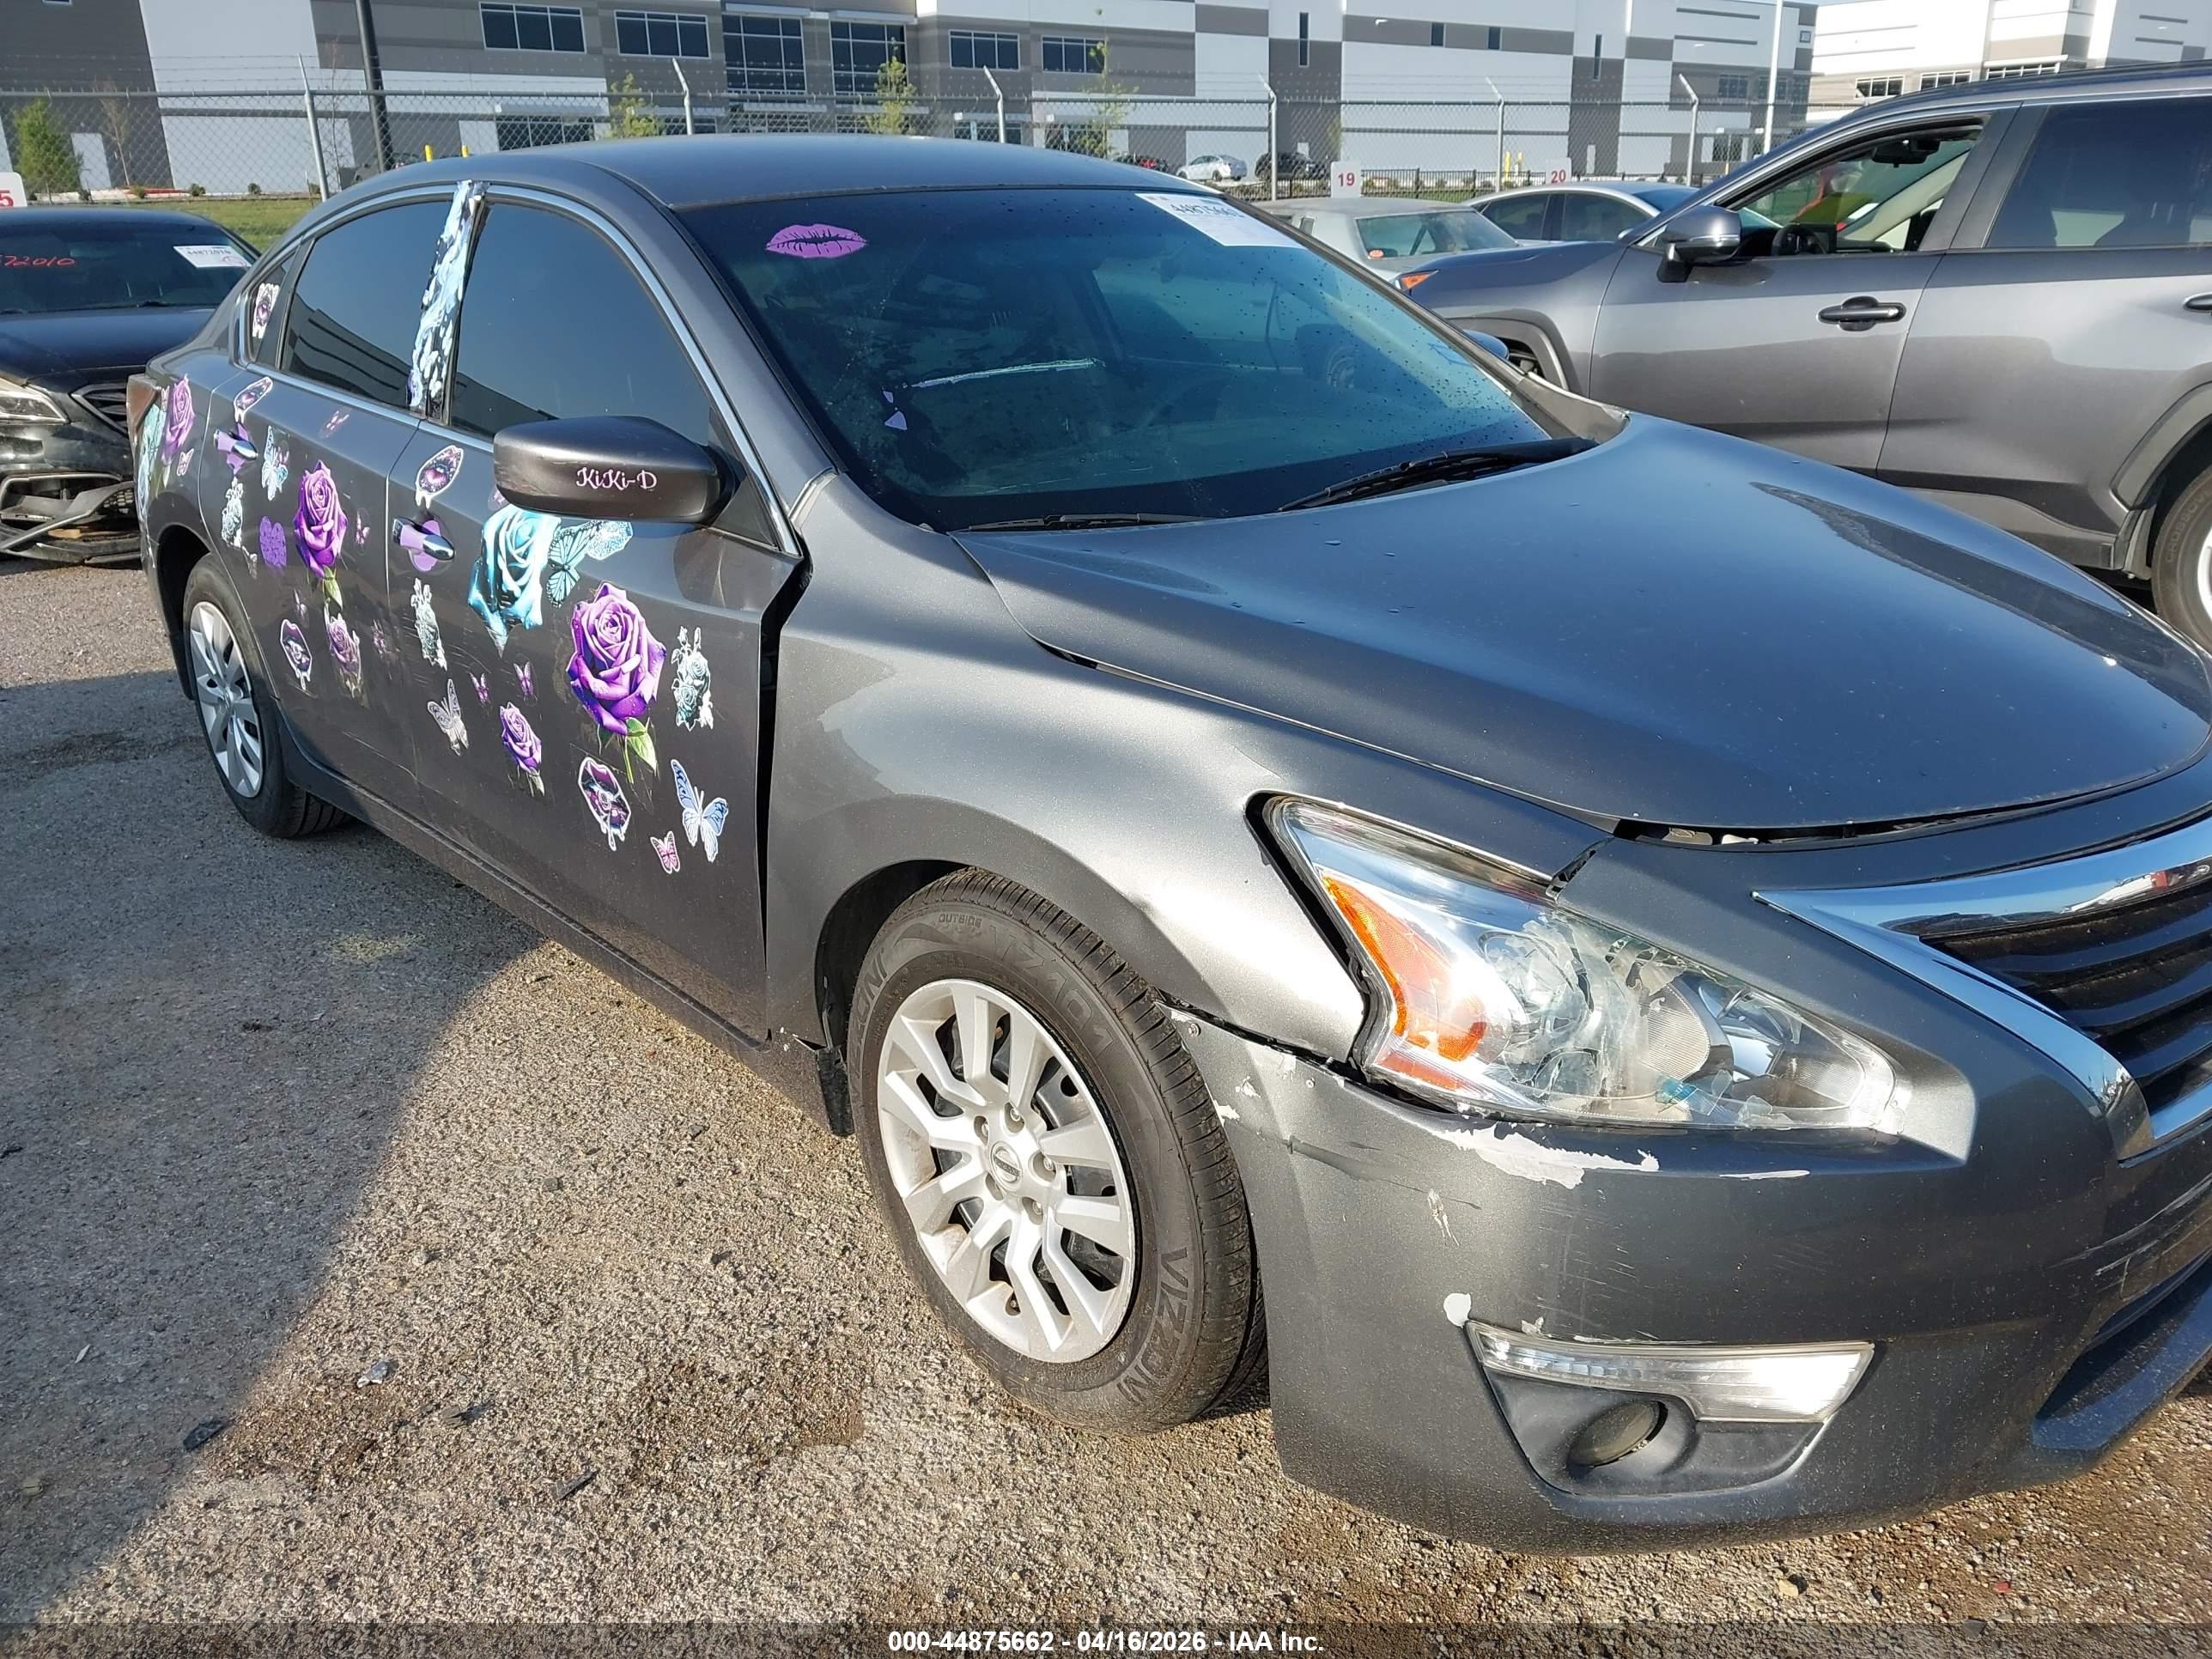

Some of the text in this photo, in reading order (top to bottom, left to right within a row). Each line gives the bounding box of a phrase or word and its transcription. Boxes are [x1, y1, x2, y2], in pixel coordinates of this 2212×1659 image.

[1338, 172, 1355, 186] 19
[1551, 169, 1566, 184] 20
[576, 467, 658, 491] KiKi-D
